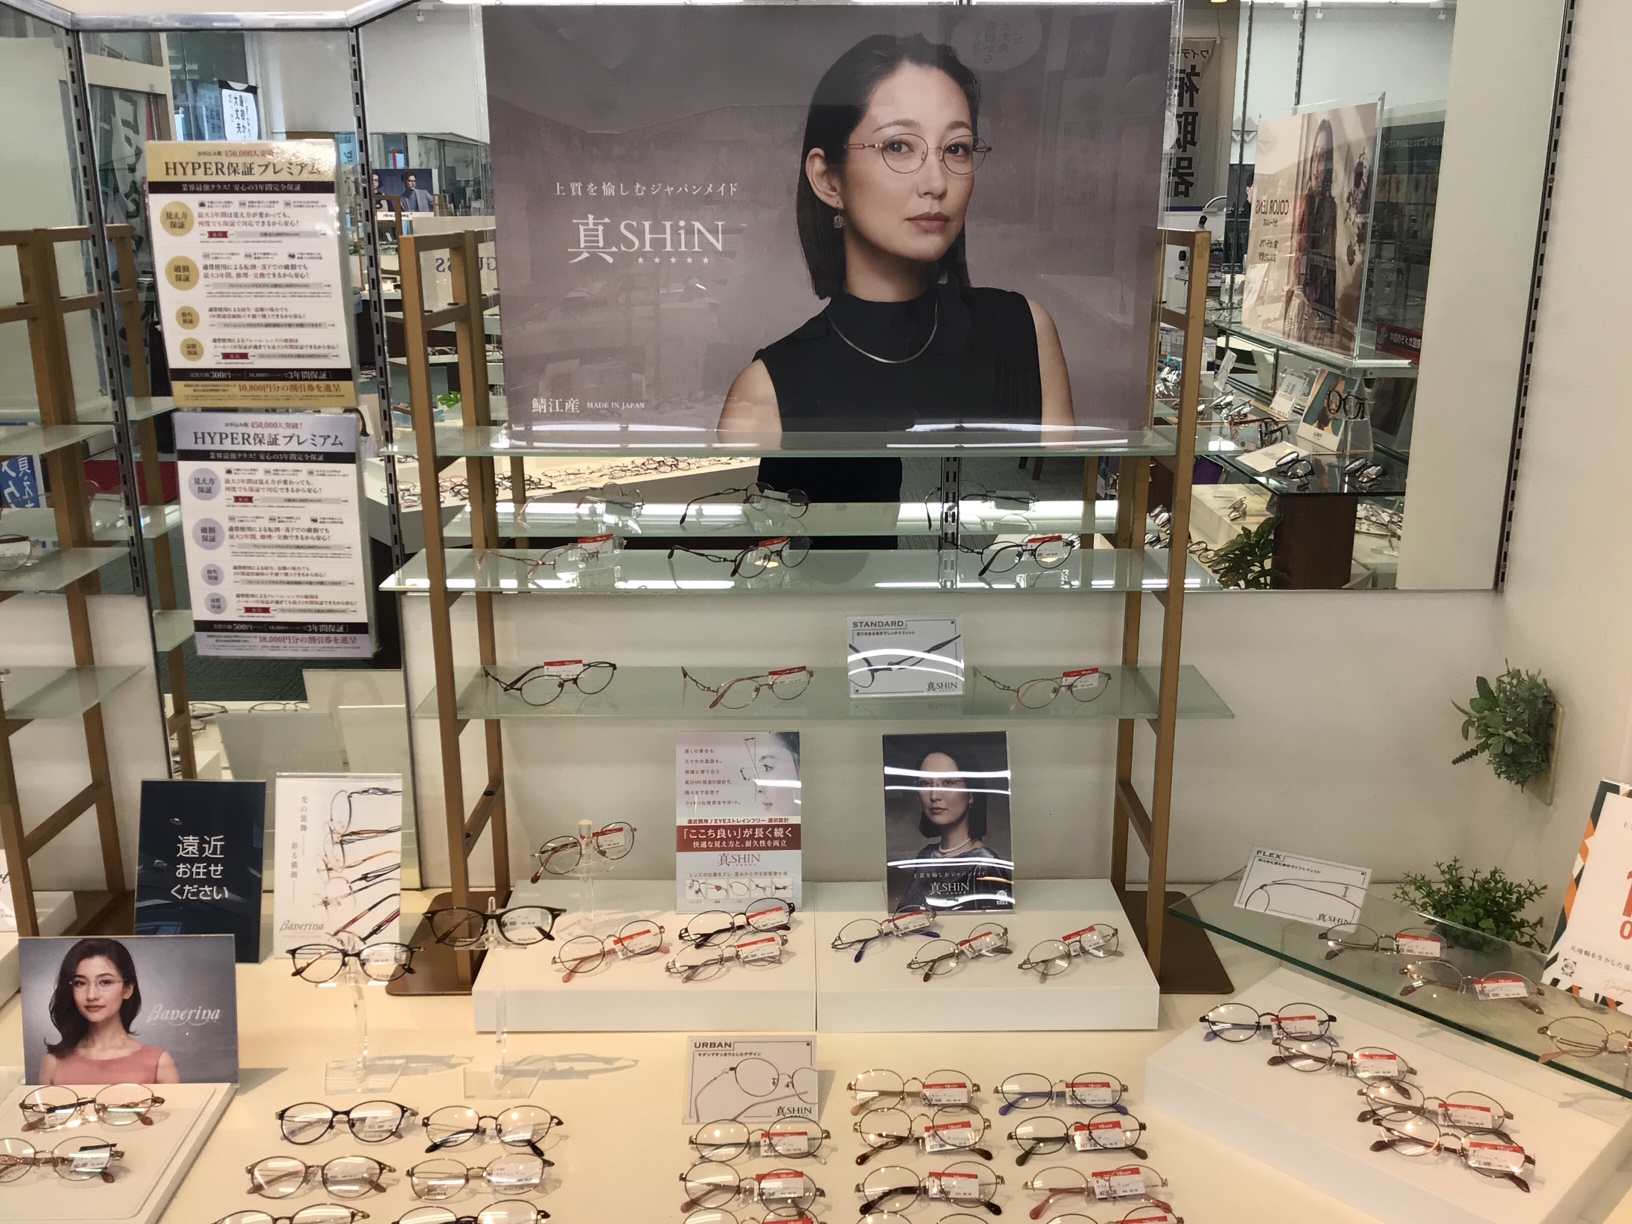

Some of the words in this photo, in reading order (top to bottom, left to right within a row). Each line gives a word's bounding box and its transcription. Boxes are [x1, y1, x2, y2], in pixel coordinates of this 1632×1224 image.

[164, 160, 321, 177] HYPER保証プレミアム
[553, 181, 739, 196] 上質を愉しむジャパンメイド
[169, 221, 186, 230] 保証
[568, 214, 726, 264] 真SHiN
[175, 274, 191, 282] 保証
[532, 397, 580, 413] 鯖江産
[587, 402, 609, 410] MADE
[611, 402, 620, 410] IN
[621, 401, 646, 410] JAPAN
[193, 431, 343, 447] HYPER保証プレミアム
[197, 485, 213, 494] 保証
[201, 535, 217, 543] 保証
[852, 620, 904, 628] STANDARD
[683, 826, 793, 840] 「ここち良い」が長く続く
[176, 834, 225, 858] 遠近
[692, 839, 788, 849] 快適な見え方と、耐久性を両立
[1256, 849, 1282, 860] FLEX
[175, 863, 224, 879] お任せ
[170, 884, 229, 900] ください
[694, 1041, 732, 1049] URBAN
